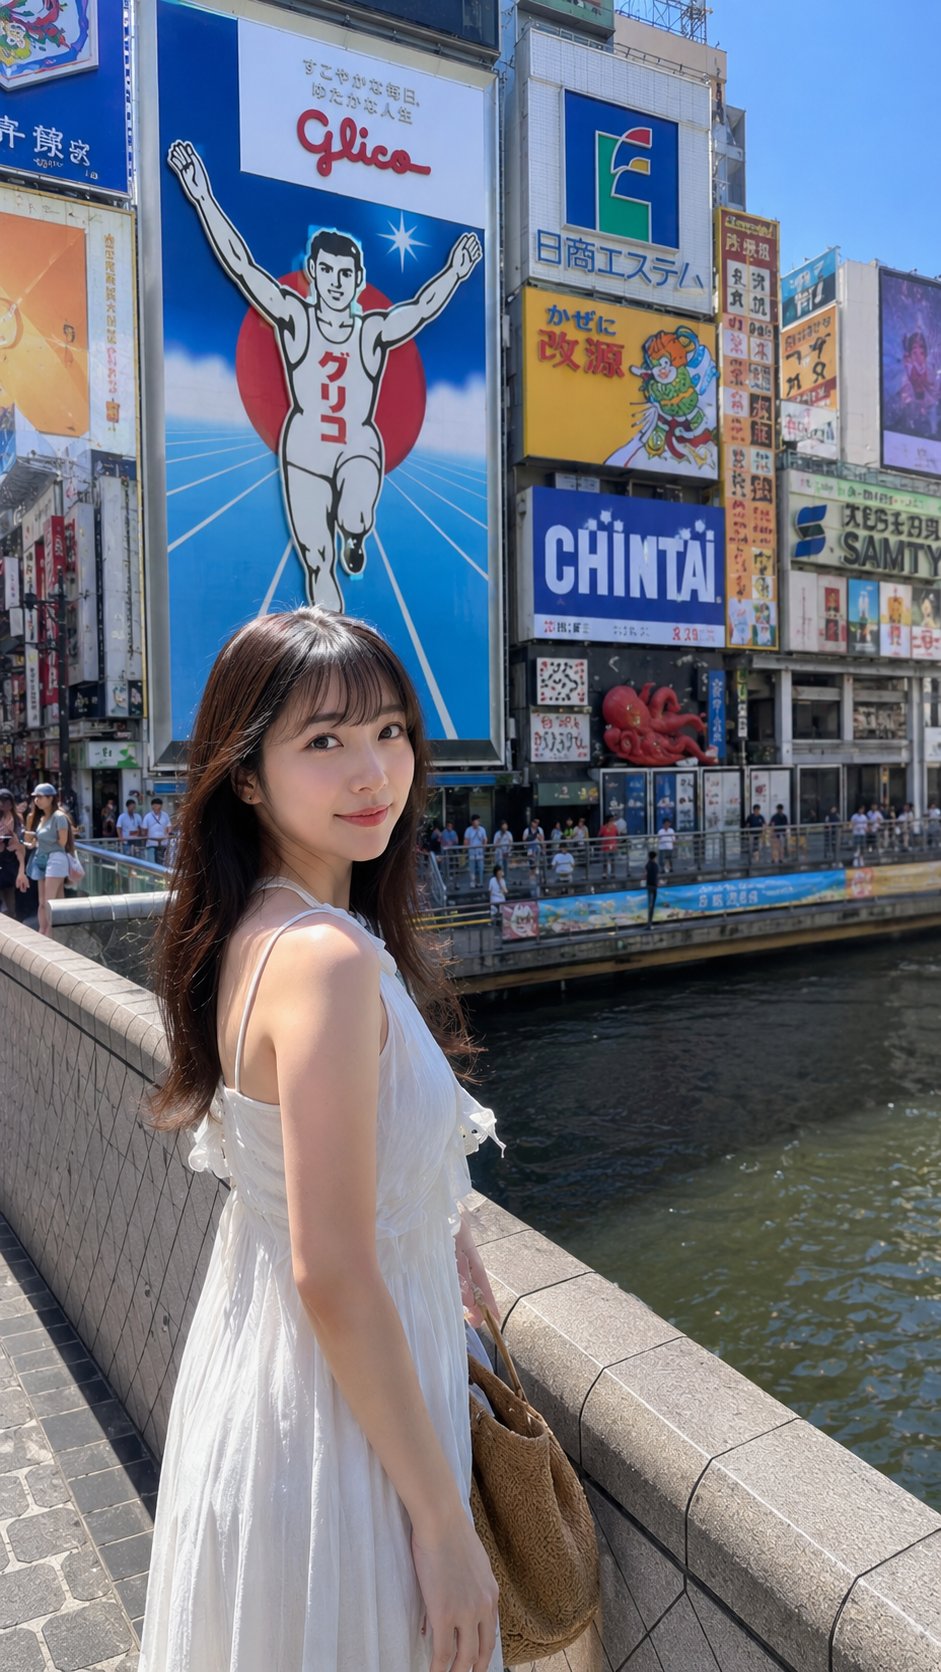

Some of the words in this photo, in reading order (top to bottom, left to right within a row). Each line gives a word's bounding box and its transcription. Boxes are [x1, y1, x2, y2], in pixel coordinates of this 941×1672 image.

[312, 82, 413, 125] ゆたかな人生
[297, 109, 431, 177] Glico
[547, 305, 617, 337] かぜに
[538, 329, 626, 379] 改源
[318, 351, 349, 445] グリコ
[842, 530, 941, 578] SAMTY
